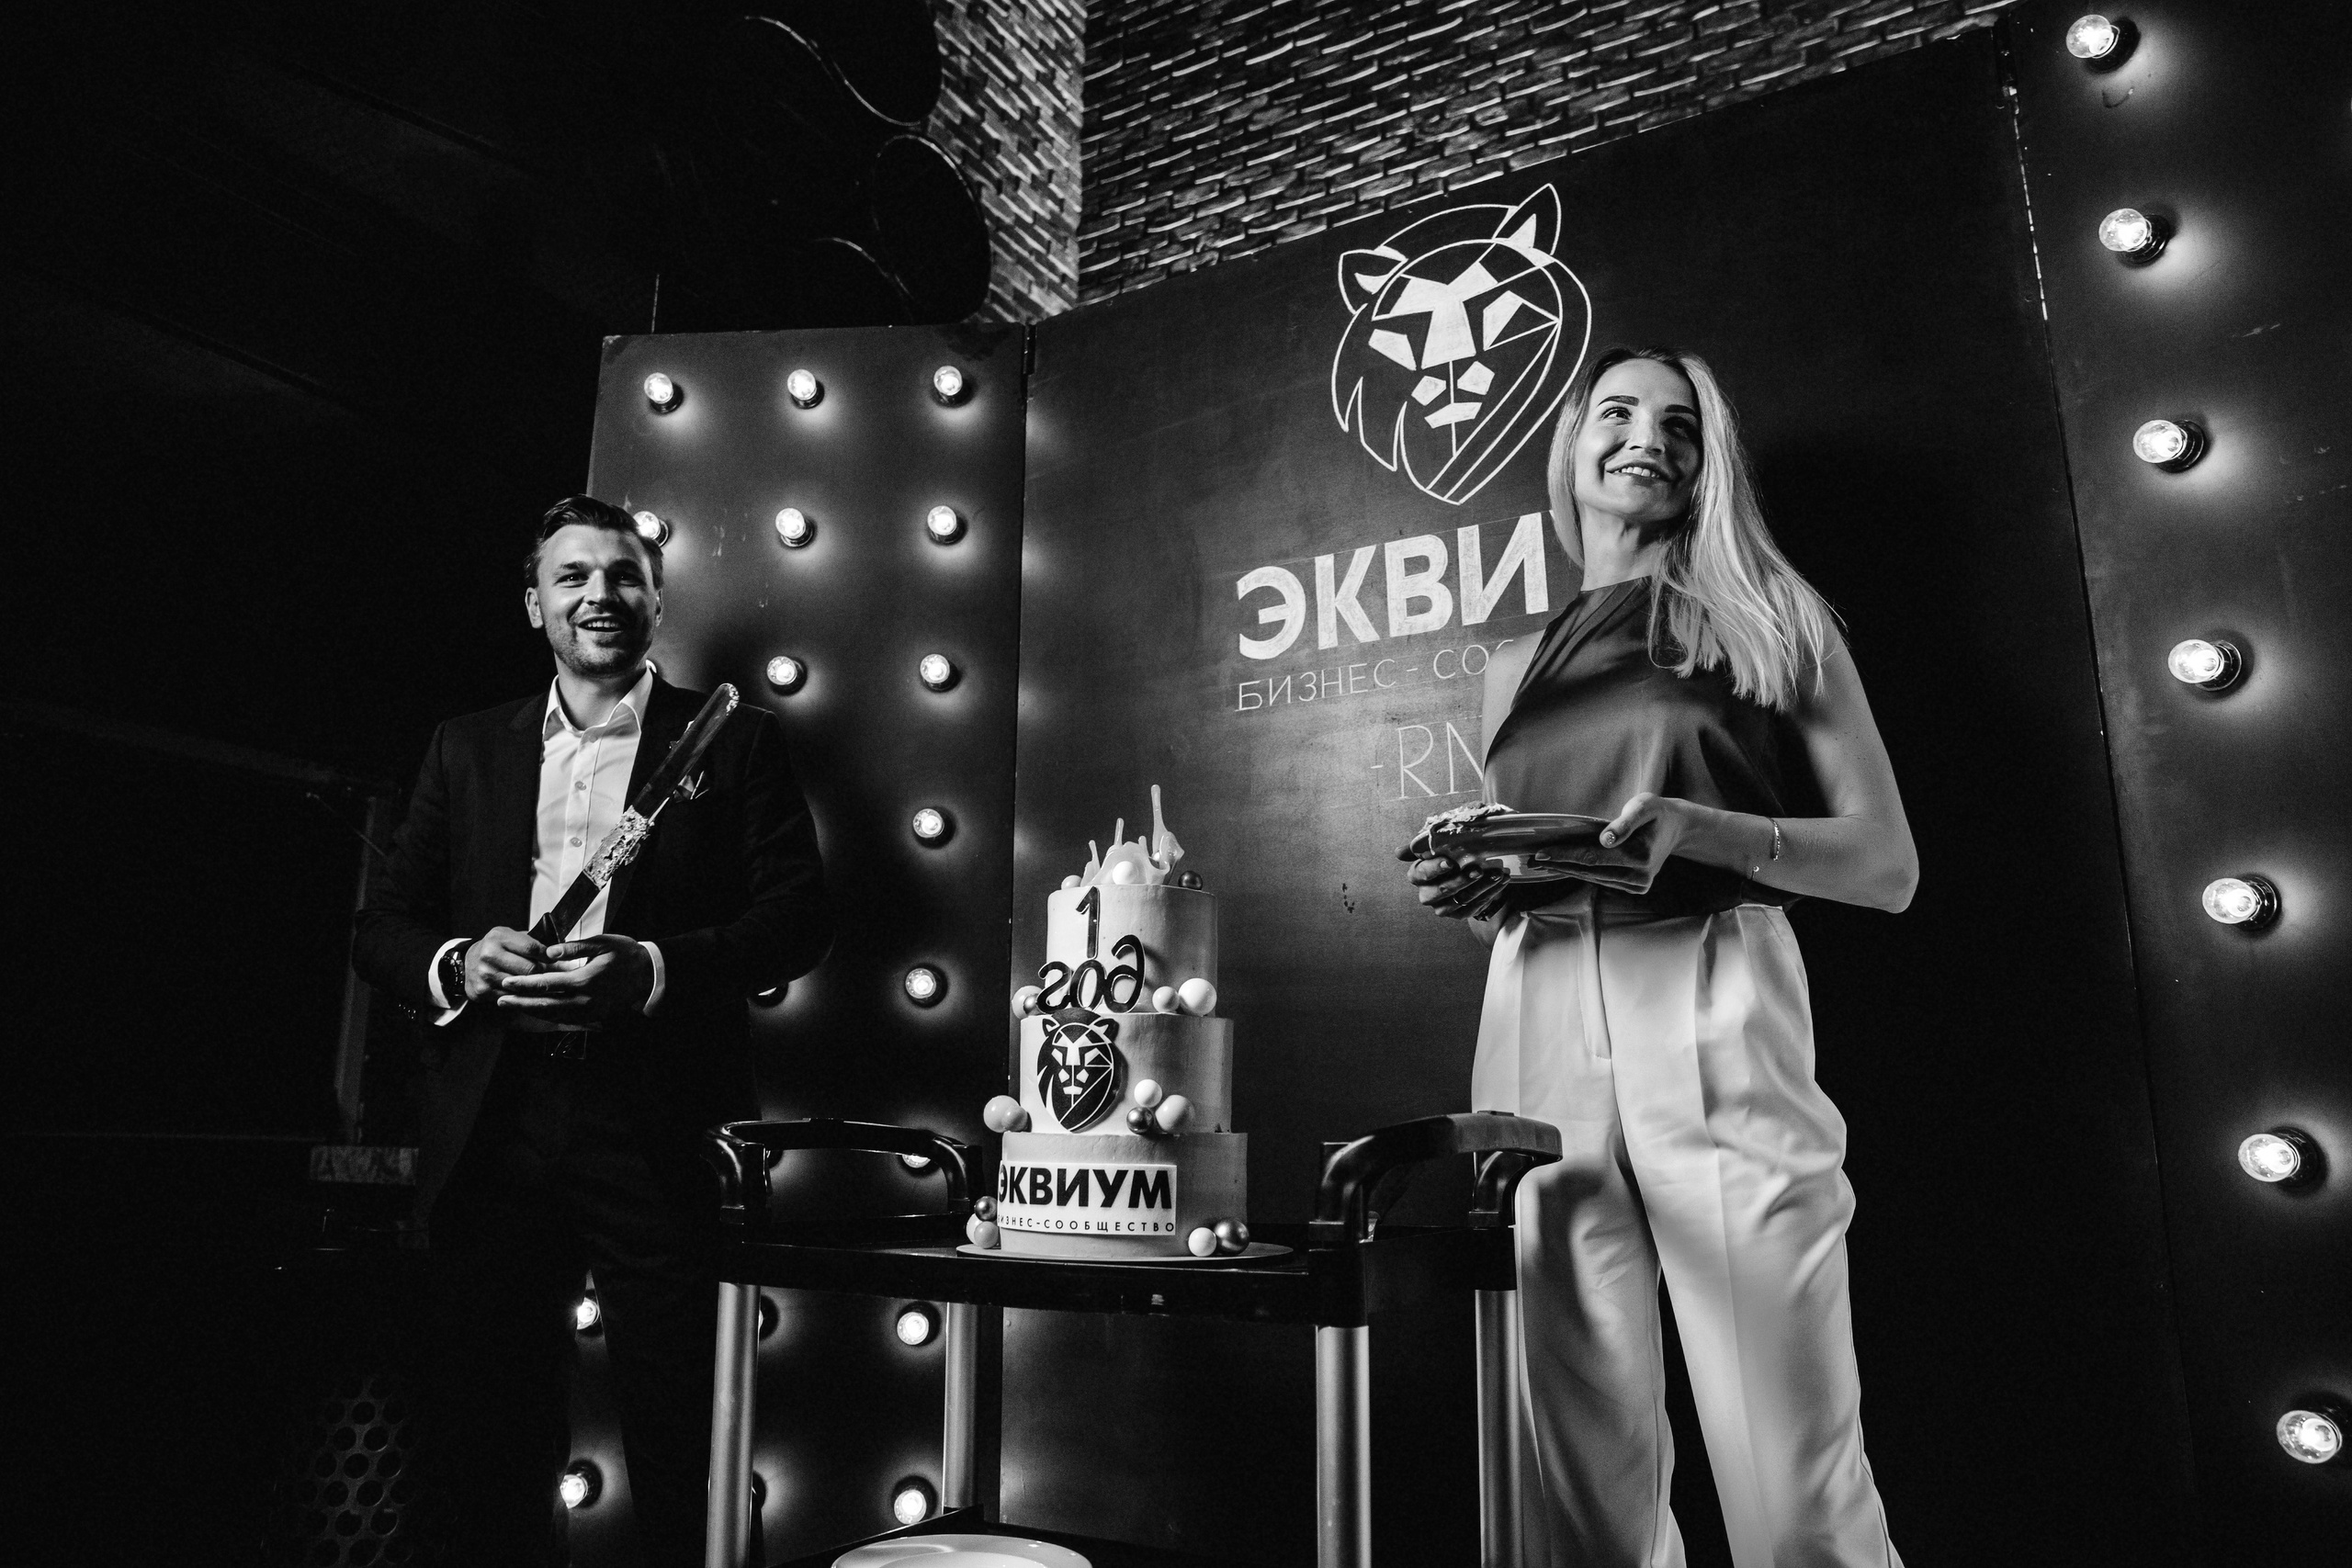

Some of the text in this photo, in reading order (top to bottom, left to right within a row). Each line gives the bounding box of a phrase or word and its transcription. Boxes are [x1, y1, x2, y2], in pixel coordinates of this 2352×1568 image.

[1237, 510, 1554, 660] ЭКВИ
[1235, 659, 1396, 712] БИЗНЕС
[1076, 886, 1100, 959] 1
[998, 1164, 1172, 1209] ЭКВИУМ
